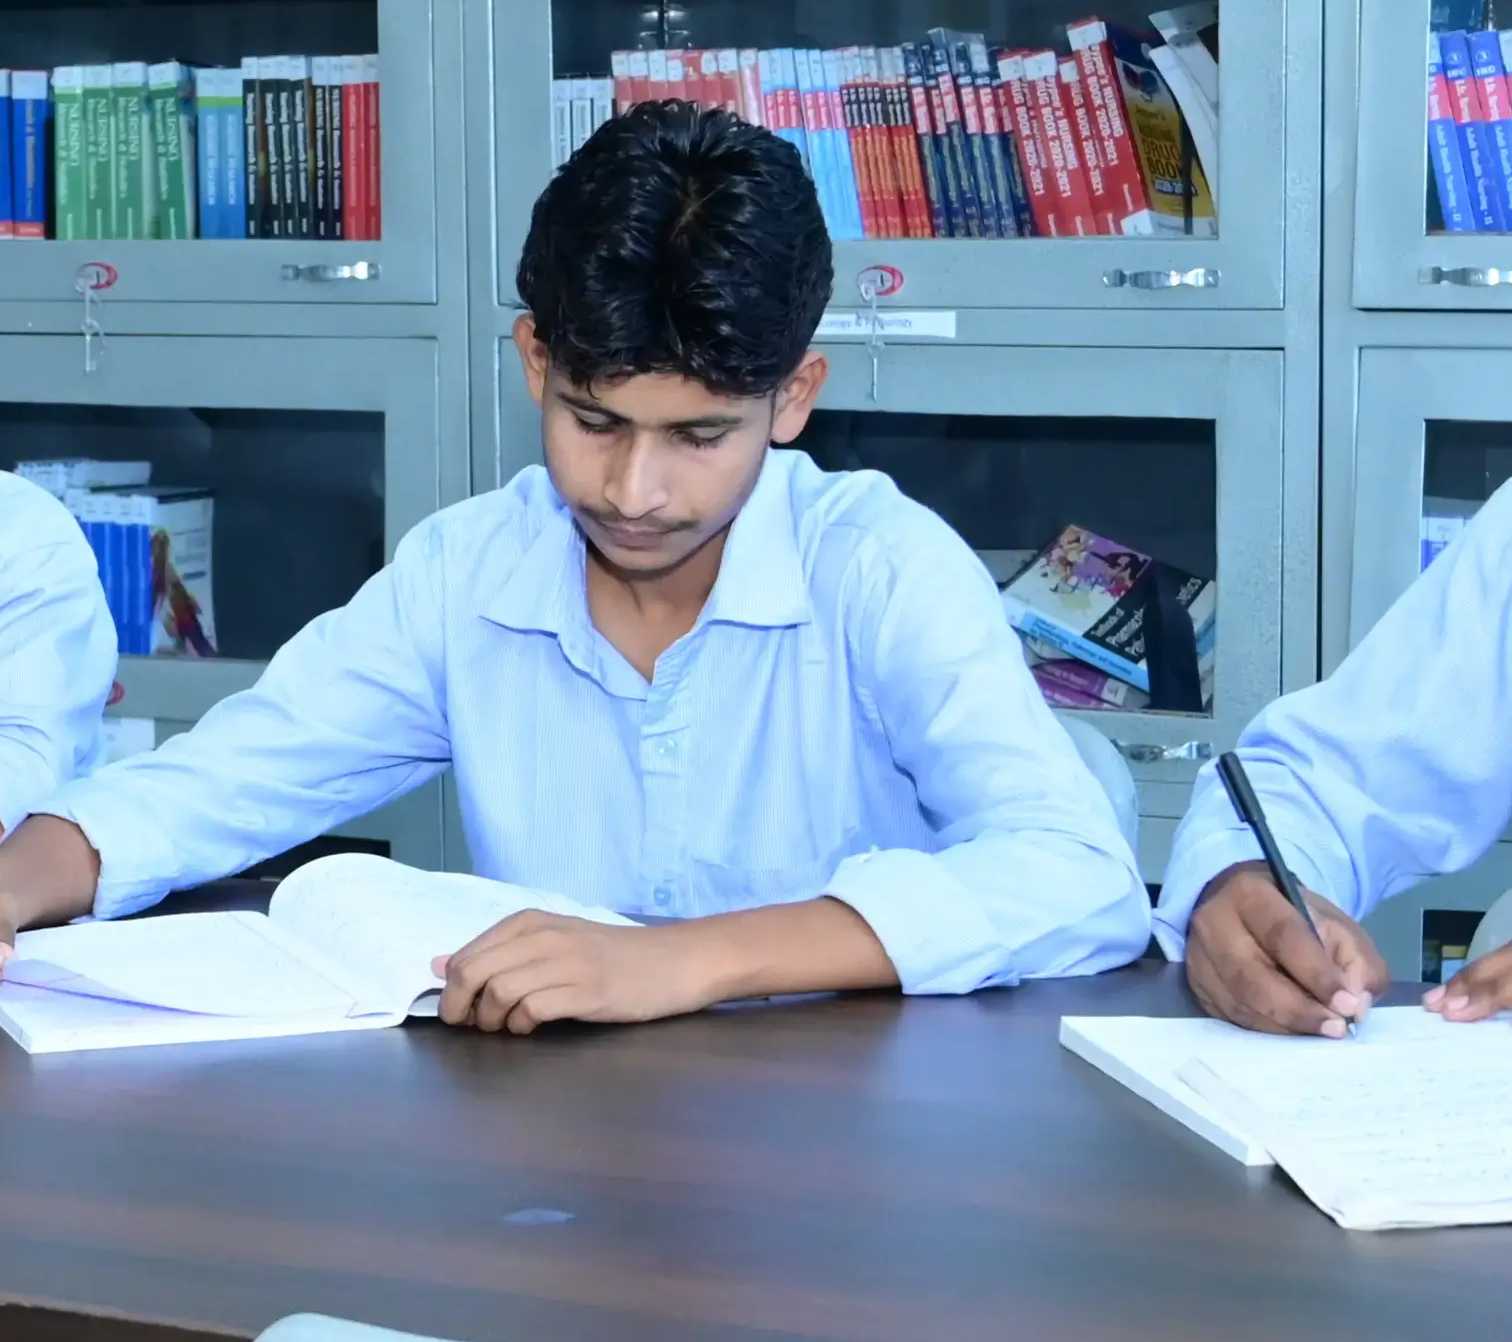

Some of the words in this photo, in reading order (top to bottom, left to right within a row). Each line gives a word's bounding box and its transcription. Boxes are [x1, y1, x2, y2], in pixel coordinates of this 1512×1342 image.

[1035, 80, 1050, 105] RUG
[1080, 49, 1094, 75] RUG
[1087, 78, 1102, 107] BOOK
[1096, 110, 1118, 167] 2020-2021
[1102, 87, 1123, 137] NURSING
[128, 96, 140, 161] NURSING
[1040, 107, 1058, 138] BOOK
[1057, 119, 1078, 170] NURSING
[1075, 109, 1092, 138] BOOK
[1049, 140, 1071, 197] 2020-2021
[1082, 140, 1104, 196] 2020-2021
